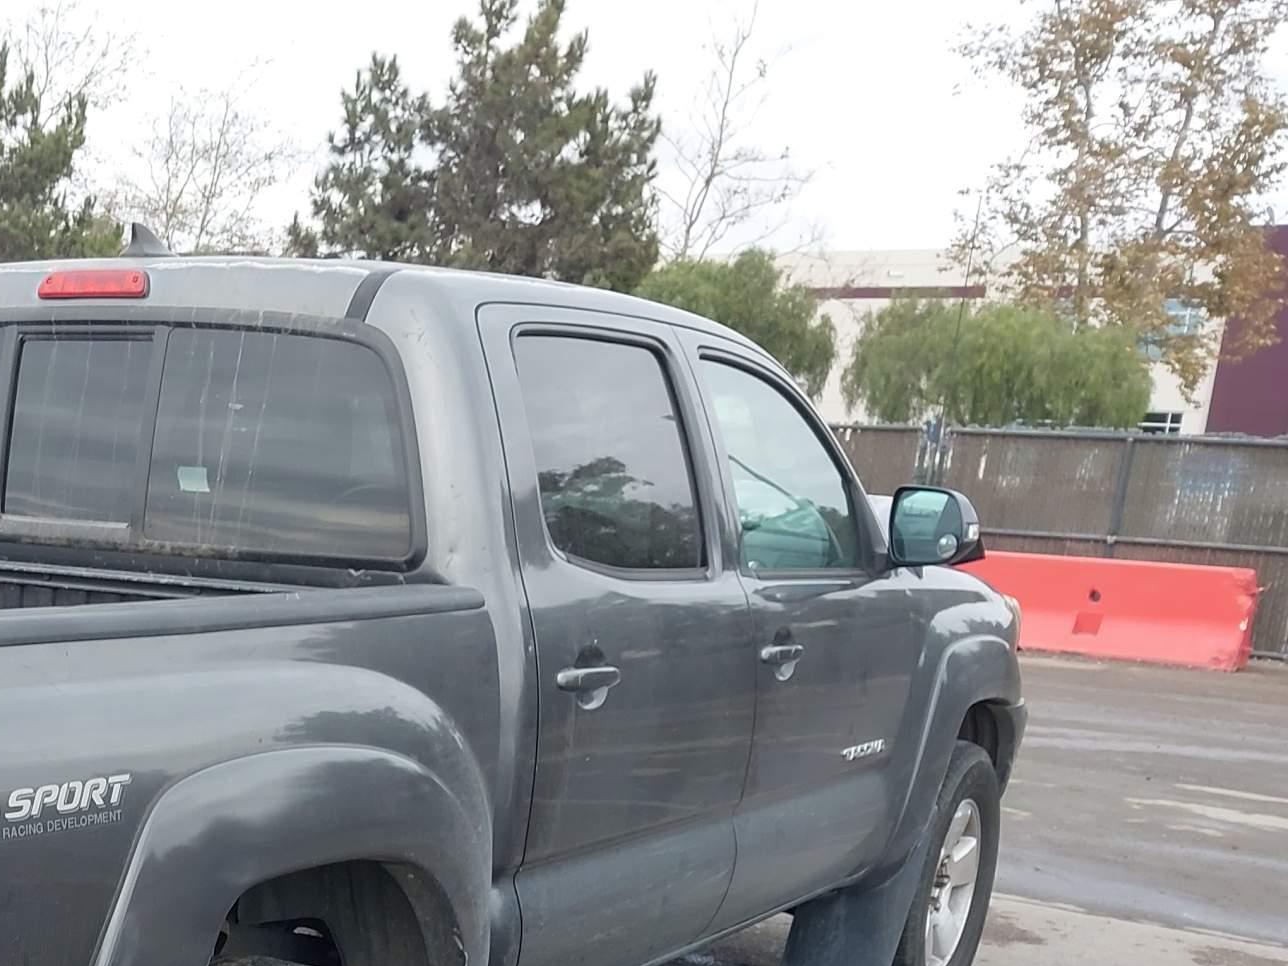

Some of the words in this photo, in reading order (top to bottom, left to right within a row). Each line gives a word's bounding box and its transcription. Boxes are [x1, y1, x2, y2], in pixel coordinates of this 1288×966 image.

[5, 773, 132, 821] SPORT
[2, 823, 44, 839] RACING
[47, 809, 122, 833] DEVELOPMENT
